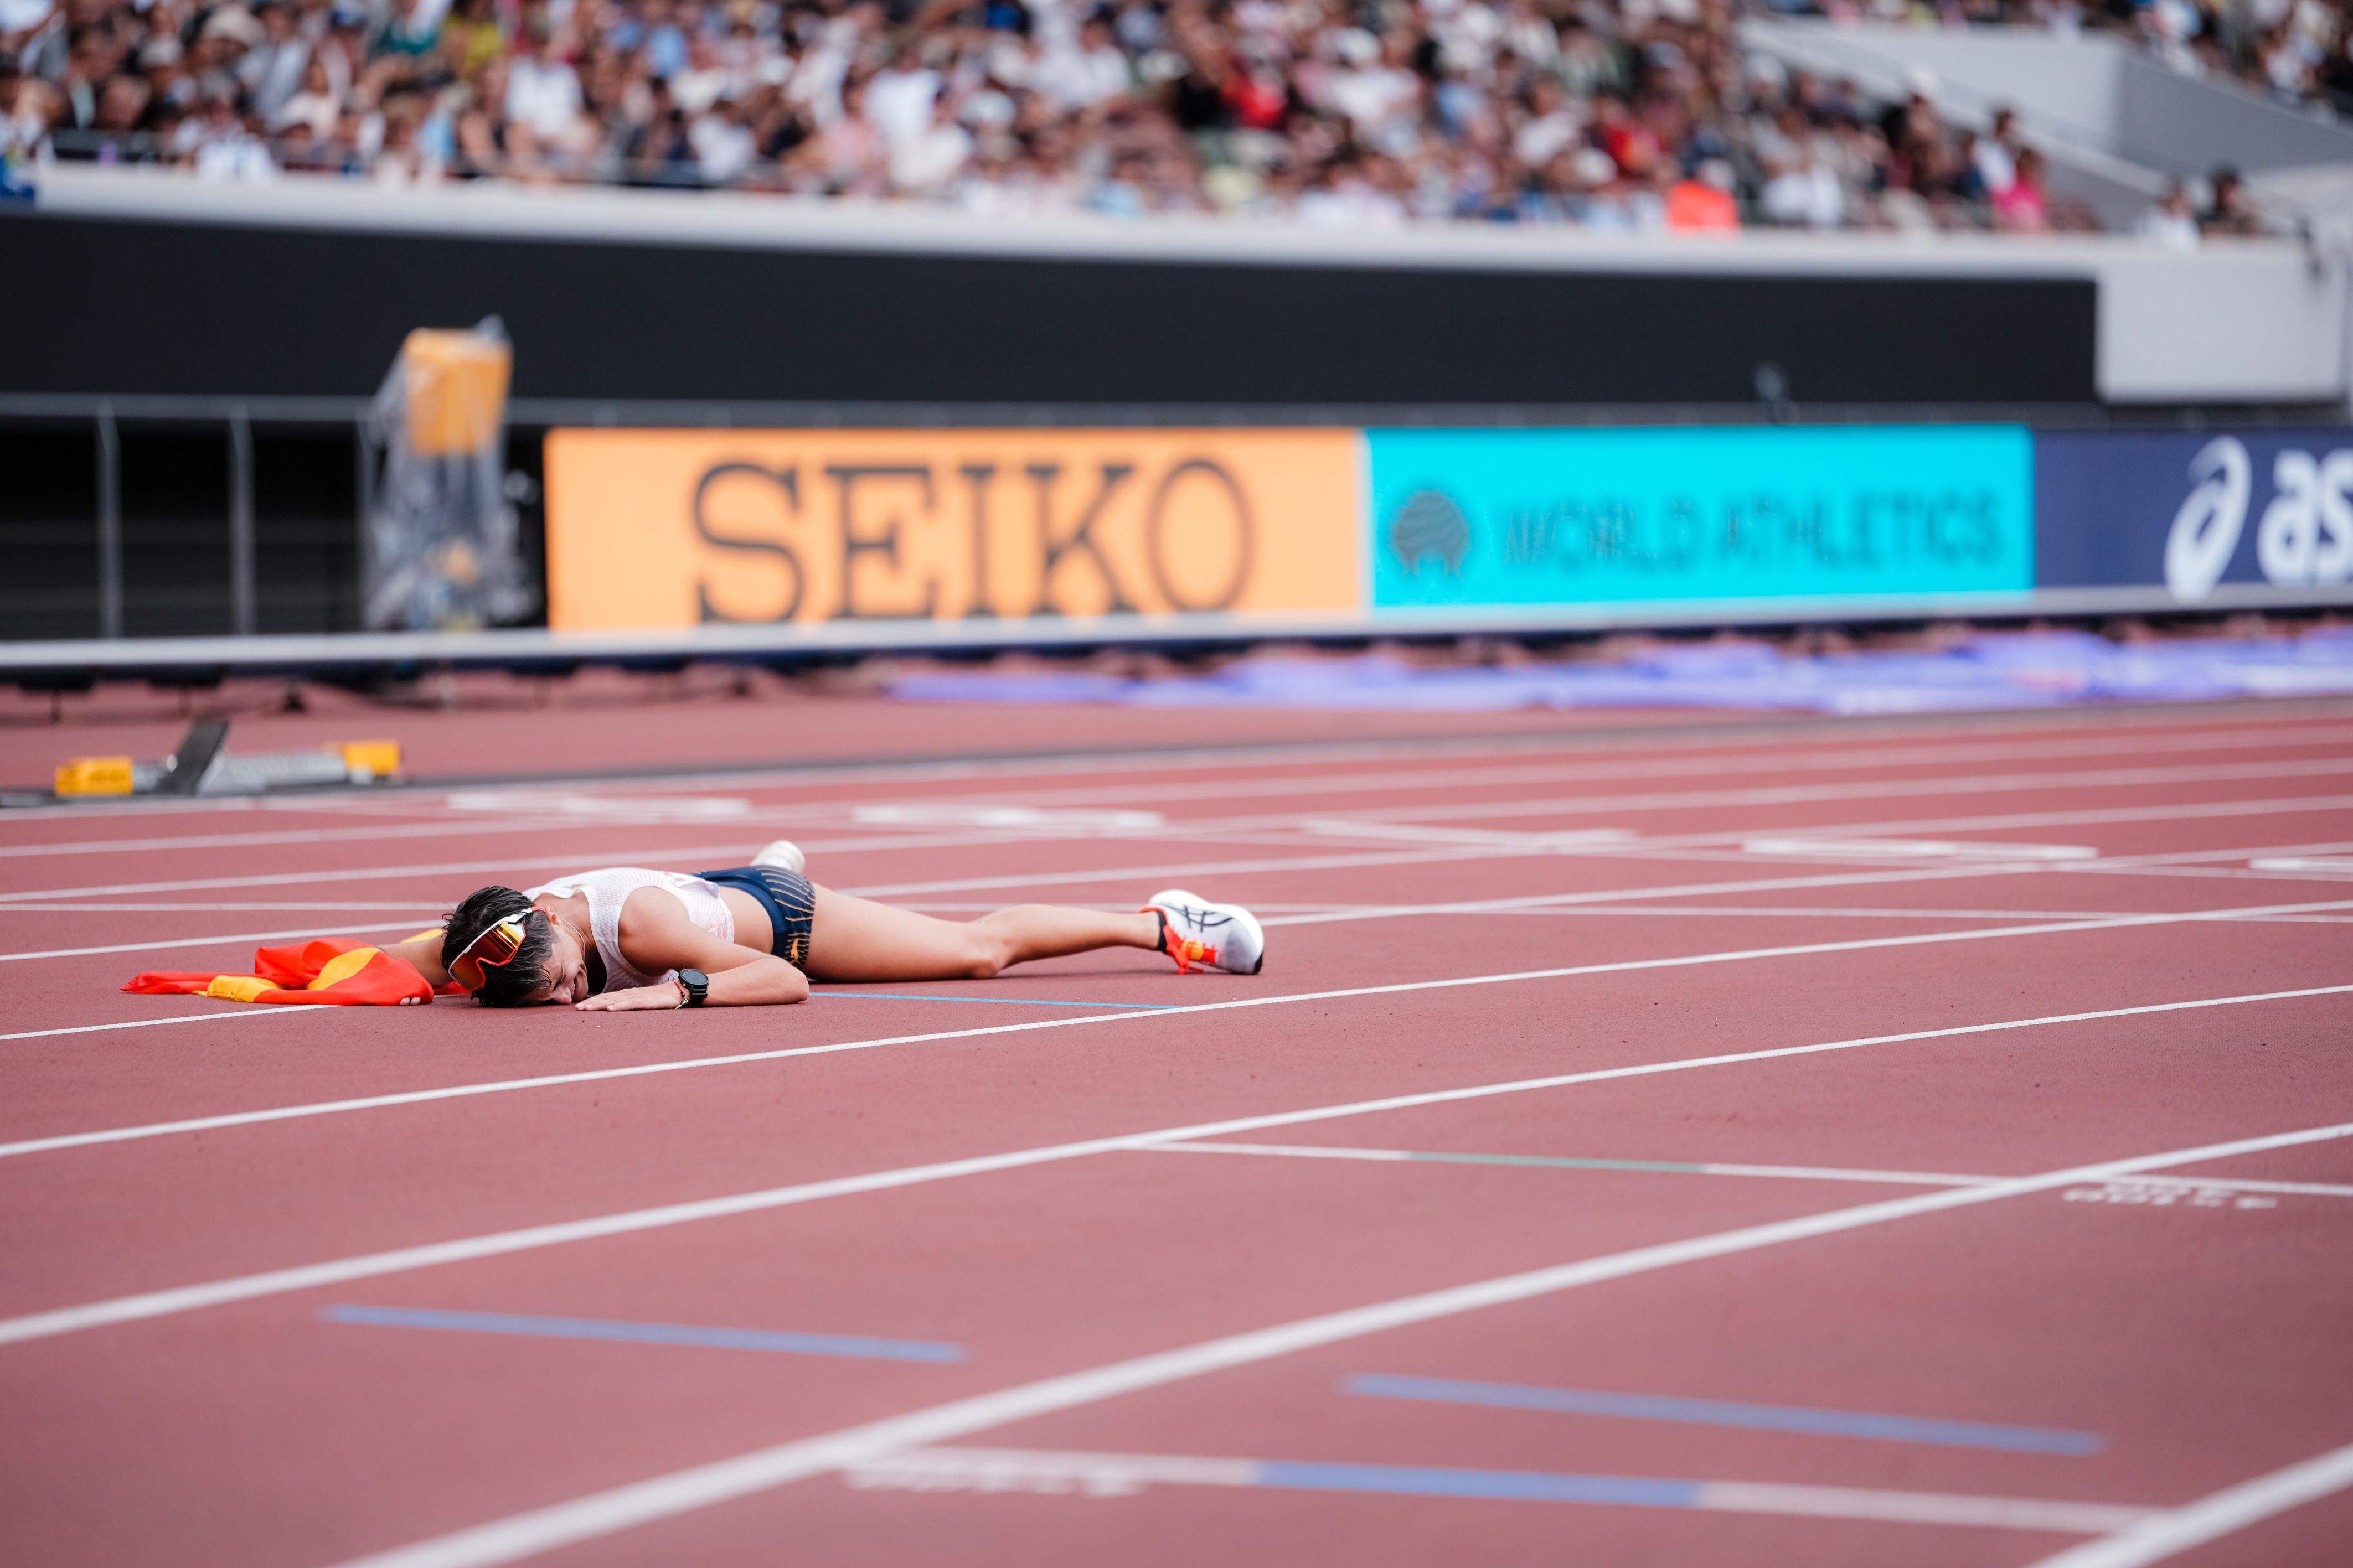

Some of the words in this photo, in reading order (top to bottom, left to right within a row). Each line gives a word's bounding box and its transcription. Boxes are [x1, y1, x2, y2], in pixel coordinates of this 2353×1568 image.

[690, 457, 1256, 622] SEIKO
[1502, 495, 1702, 574] WORLD
[1717, 489, 2003, 570] ATHLETICS
